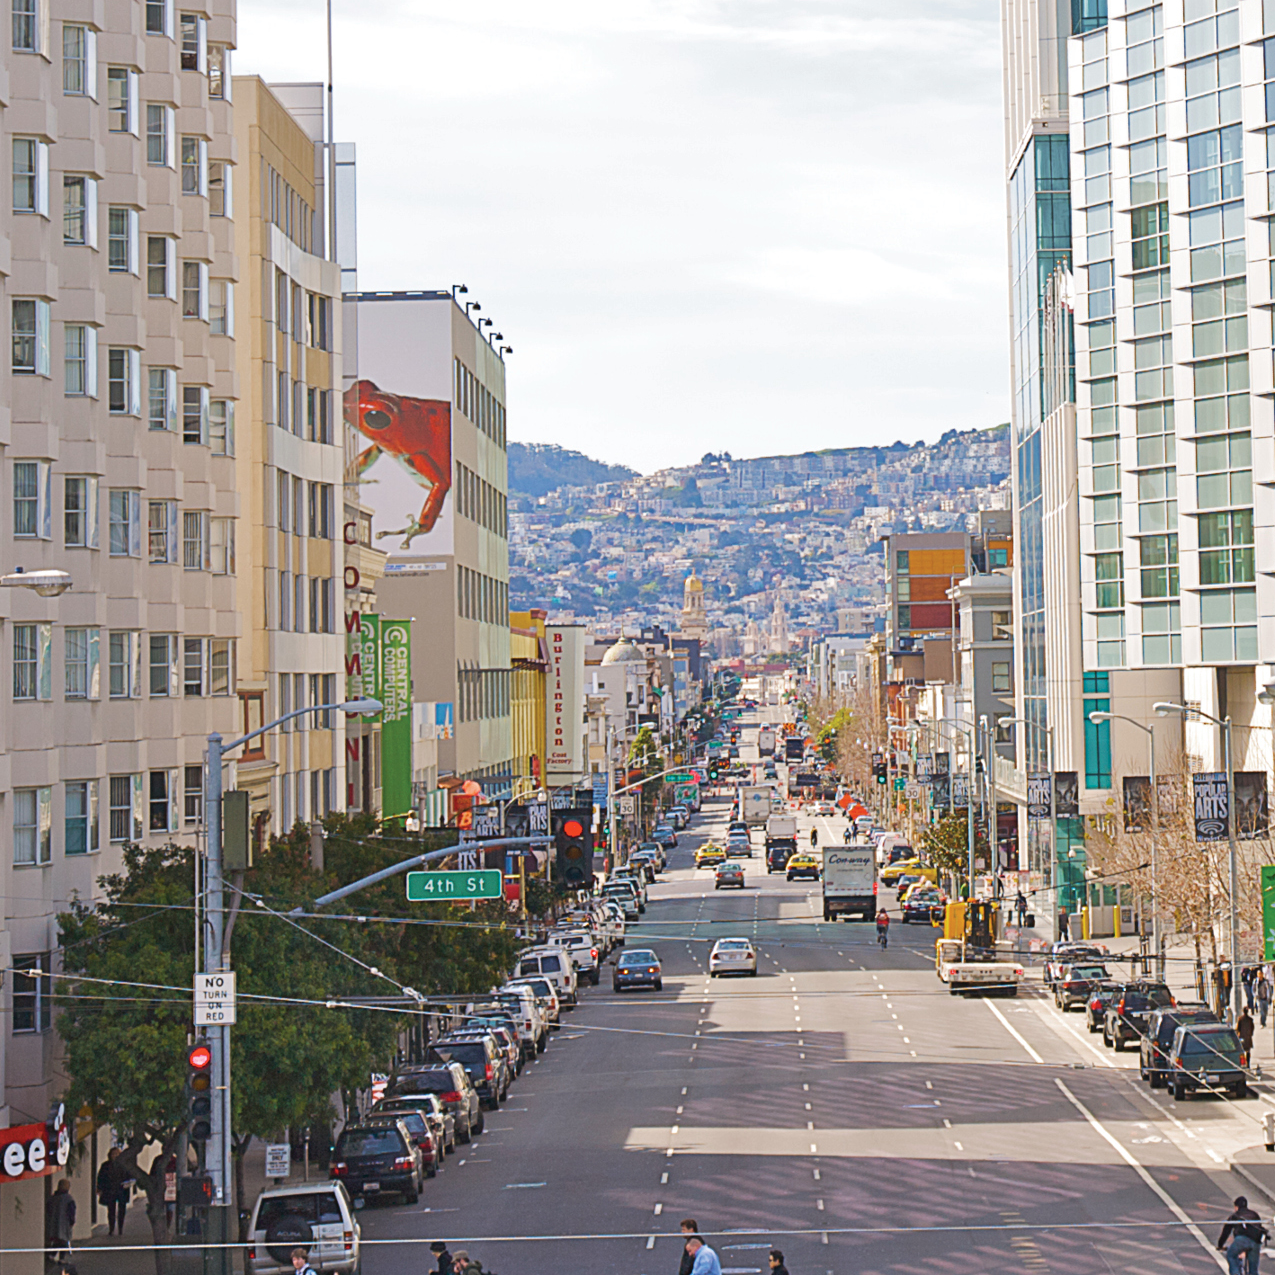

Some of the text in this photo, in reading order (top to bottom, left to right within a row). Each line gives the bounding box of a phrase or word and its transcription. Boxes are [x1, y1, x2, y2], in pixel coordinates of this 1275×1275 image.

[364, 641, 375, 696] CENTR
[384, 647, 395, 721] COMPUTERS
[397, 647, 408, 721] CENTRAL
[553, 633, 563, 746] Burlington
[1028, 788, 1051, 805] ARTS
[1195, 784, 1227, 797] POPULAR
[1196, 796, 1228, 820] ARTS
[424, 877, 485, 893] 4th St
[205, 977, 224, 988] NO
[203, 990, 227, 1000] TURN
[208, 1002, 223, 1010] ON
[206, 1012, 224, 1021] RED
